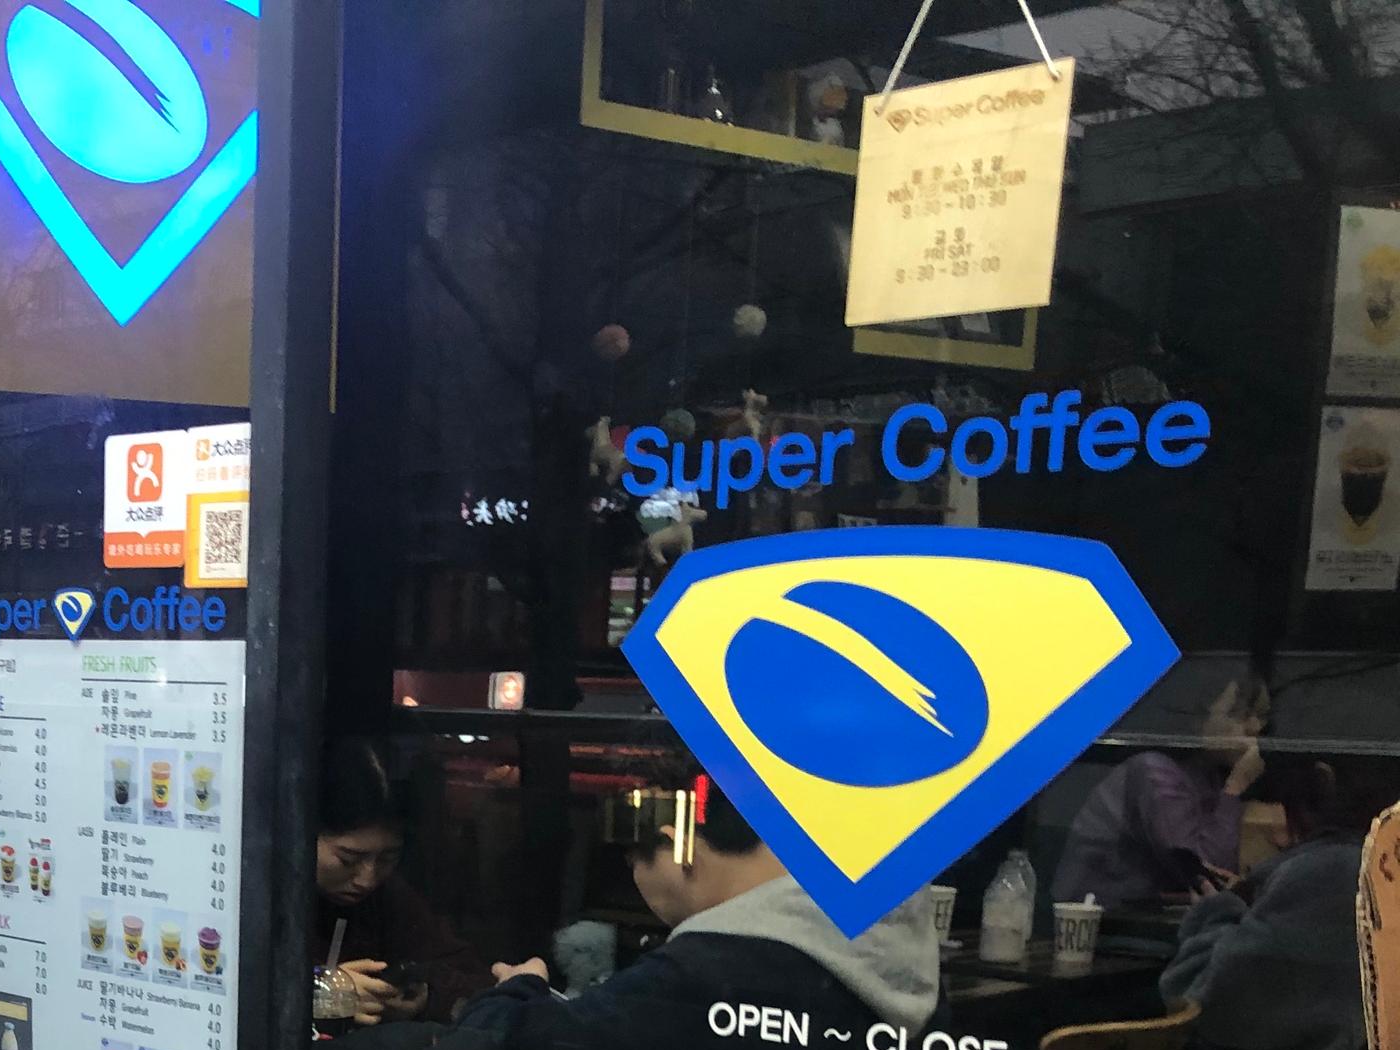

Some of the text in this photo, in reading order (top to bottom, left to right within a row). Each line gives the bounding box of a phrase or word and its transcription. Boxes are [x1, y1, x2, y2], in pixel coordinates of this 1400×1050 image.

[976, 89, 1045, 114] Coffee
[622, 388, 1211, 509] Super Coffee
[104, 585, 227, 632] Coffee
[82, 656, 157, 673] FRESH FRUITS
[213, 692, 227, 705] 3.5
[212, 844, 225, 857] 4.0
[212, 862, 225, 875] 4.0
[211, 880, 225, 892] 4.0
[211, 898, 224, 911] 4.0
[100, 981, 144, 1000] 딸기바나나
[208, 1003, 221, 1016] 4.0
[208, 1020, 221, 1034] 4.0
[708, 1001, 810, 1047] OPEN
[208, 1038, 220, 1050] 4.0
